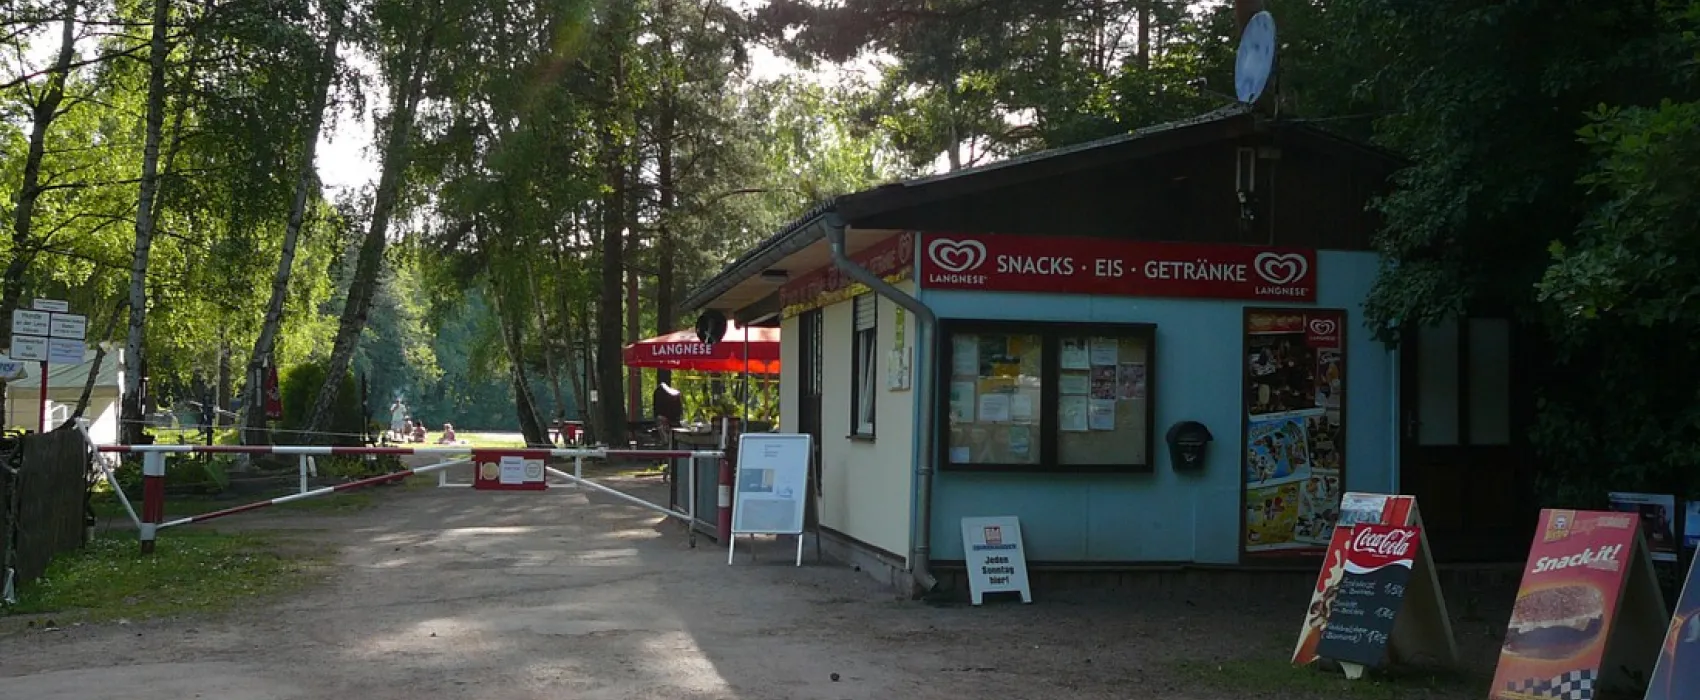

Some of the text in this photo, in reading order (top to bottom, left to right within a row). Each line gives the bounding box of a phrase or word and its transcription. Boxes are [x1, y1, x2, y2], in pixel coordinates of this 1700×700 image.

[997, 254, 1248, 283] SNACKS EIS GETRÄNKE
[929, 273, 985, 285] LANGNESE
[1254, 285, 1308, 297] LANGNESE
[651, 343, 712, 356] LANGNESE
[985, 556, 1009, 564] Jeden
[1531, 547, 1594, 574] Snack
[1594, 543, 1622, 562] it!
[981, 565, 1015, 575] Sonntag
[989, 576, 1010, 585] hier!
